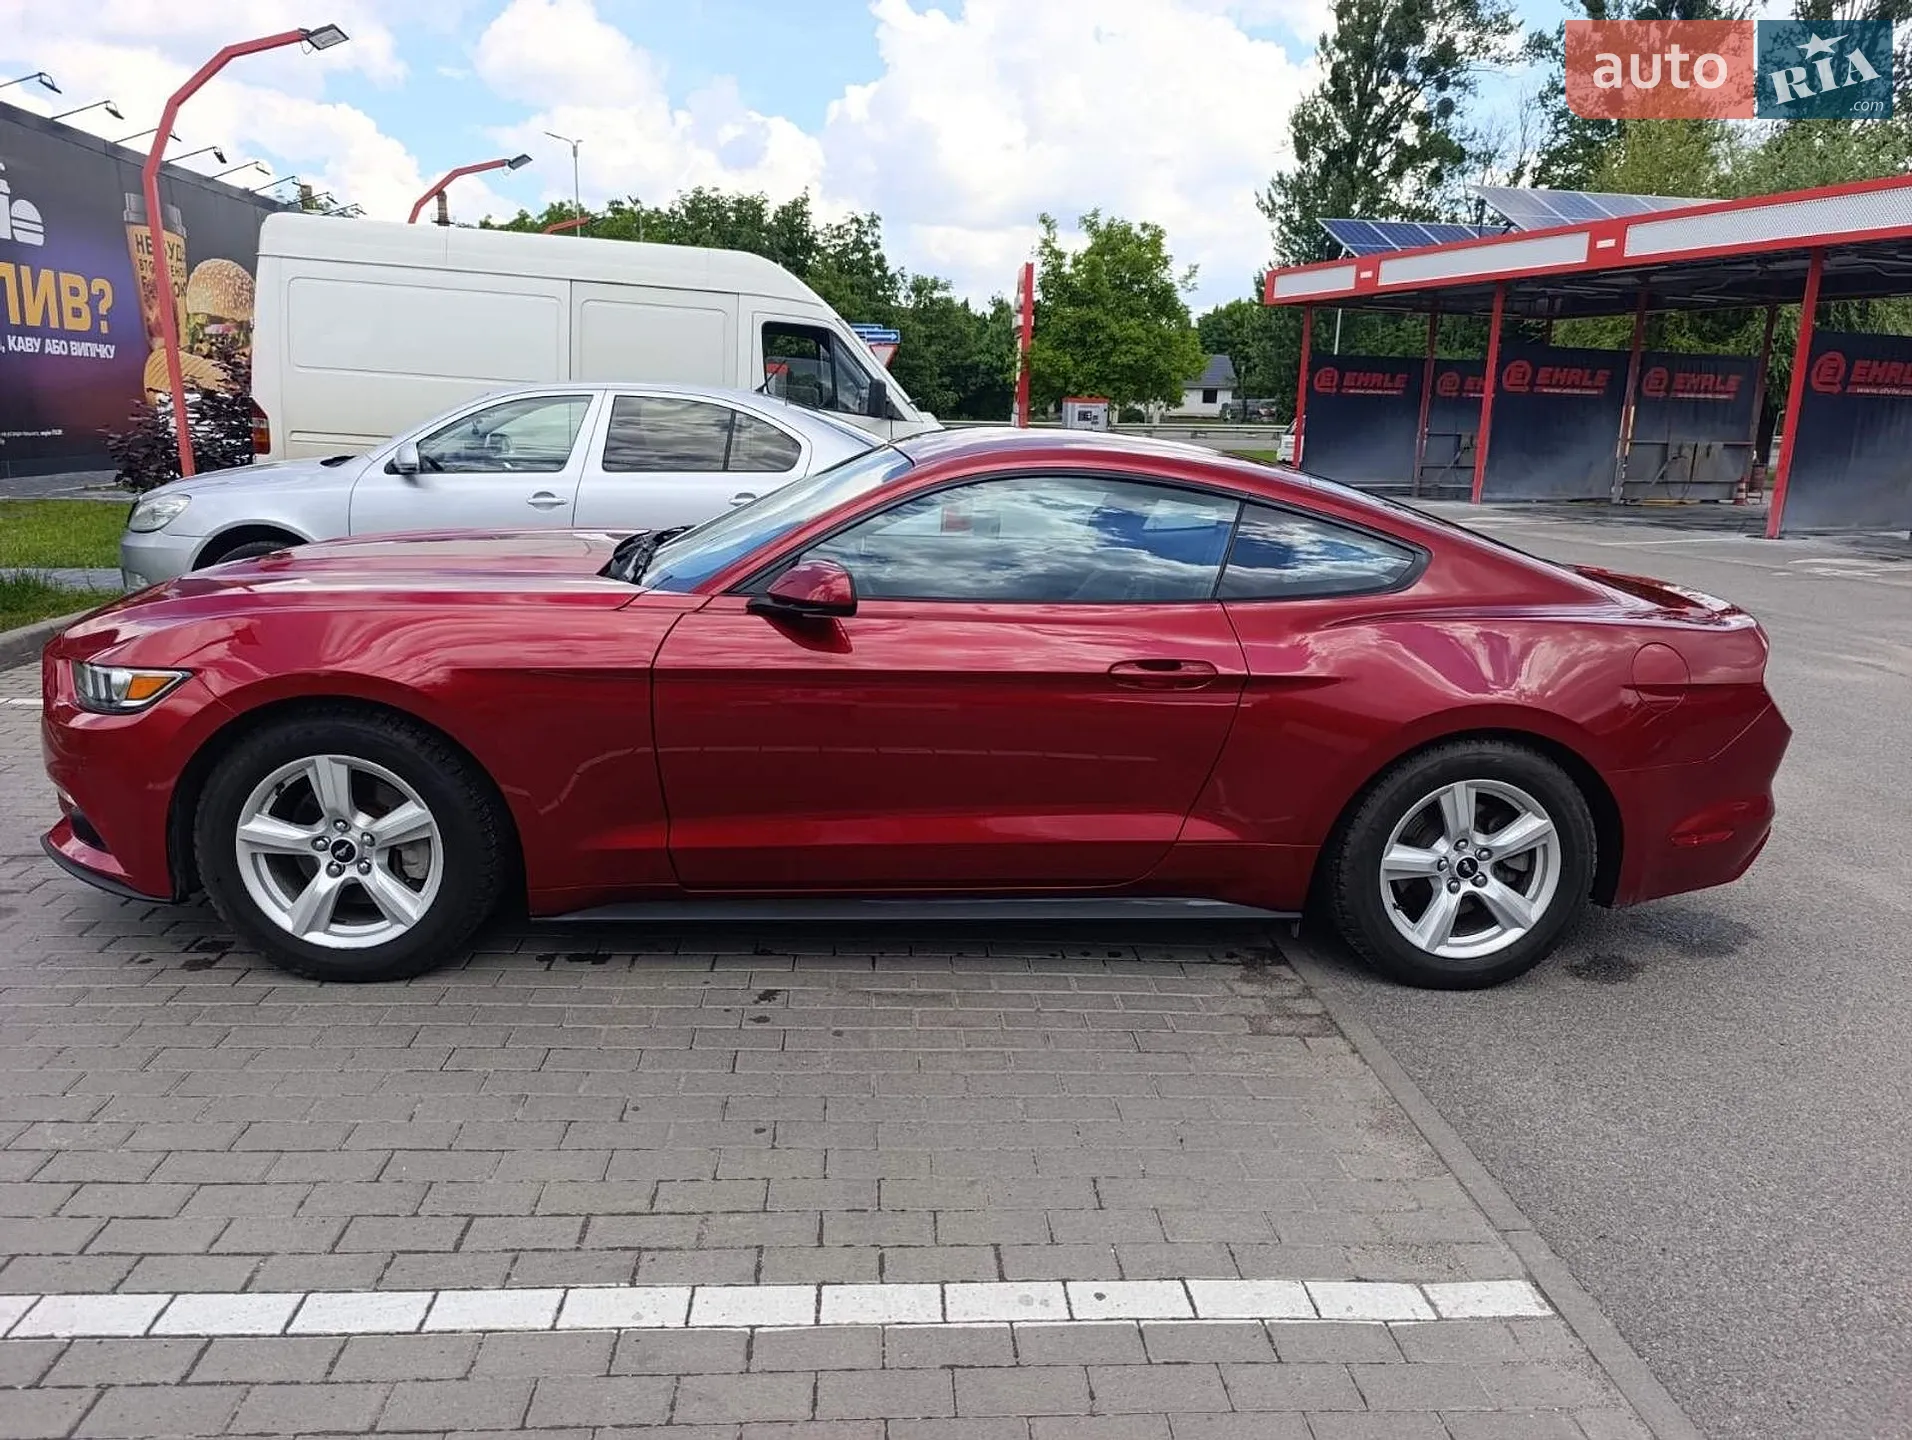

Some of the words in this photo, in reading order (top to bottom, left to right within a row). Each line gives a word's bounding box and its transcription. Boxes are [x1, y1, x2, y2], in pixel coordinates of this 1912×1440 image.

[8, 334, 41, 353] КАВУ
[45, 339, 68, 355] АБО
[70, 341, 115, 359] ВИПІЧКУ
[1343, 371, 1410, 388] EHRLE
[1536, 366, 1612, 386] EHRLE
[1673, 373, 1742, 391] EHRLE
